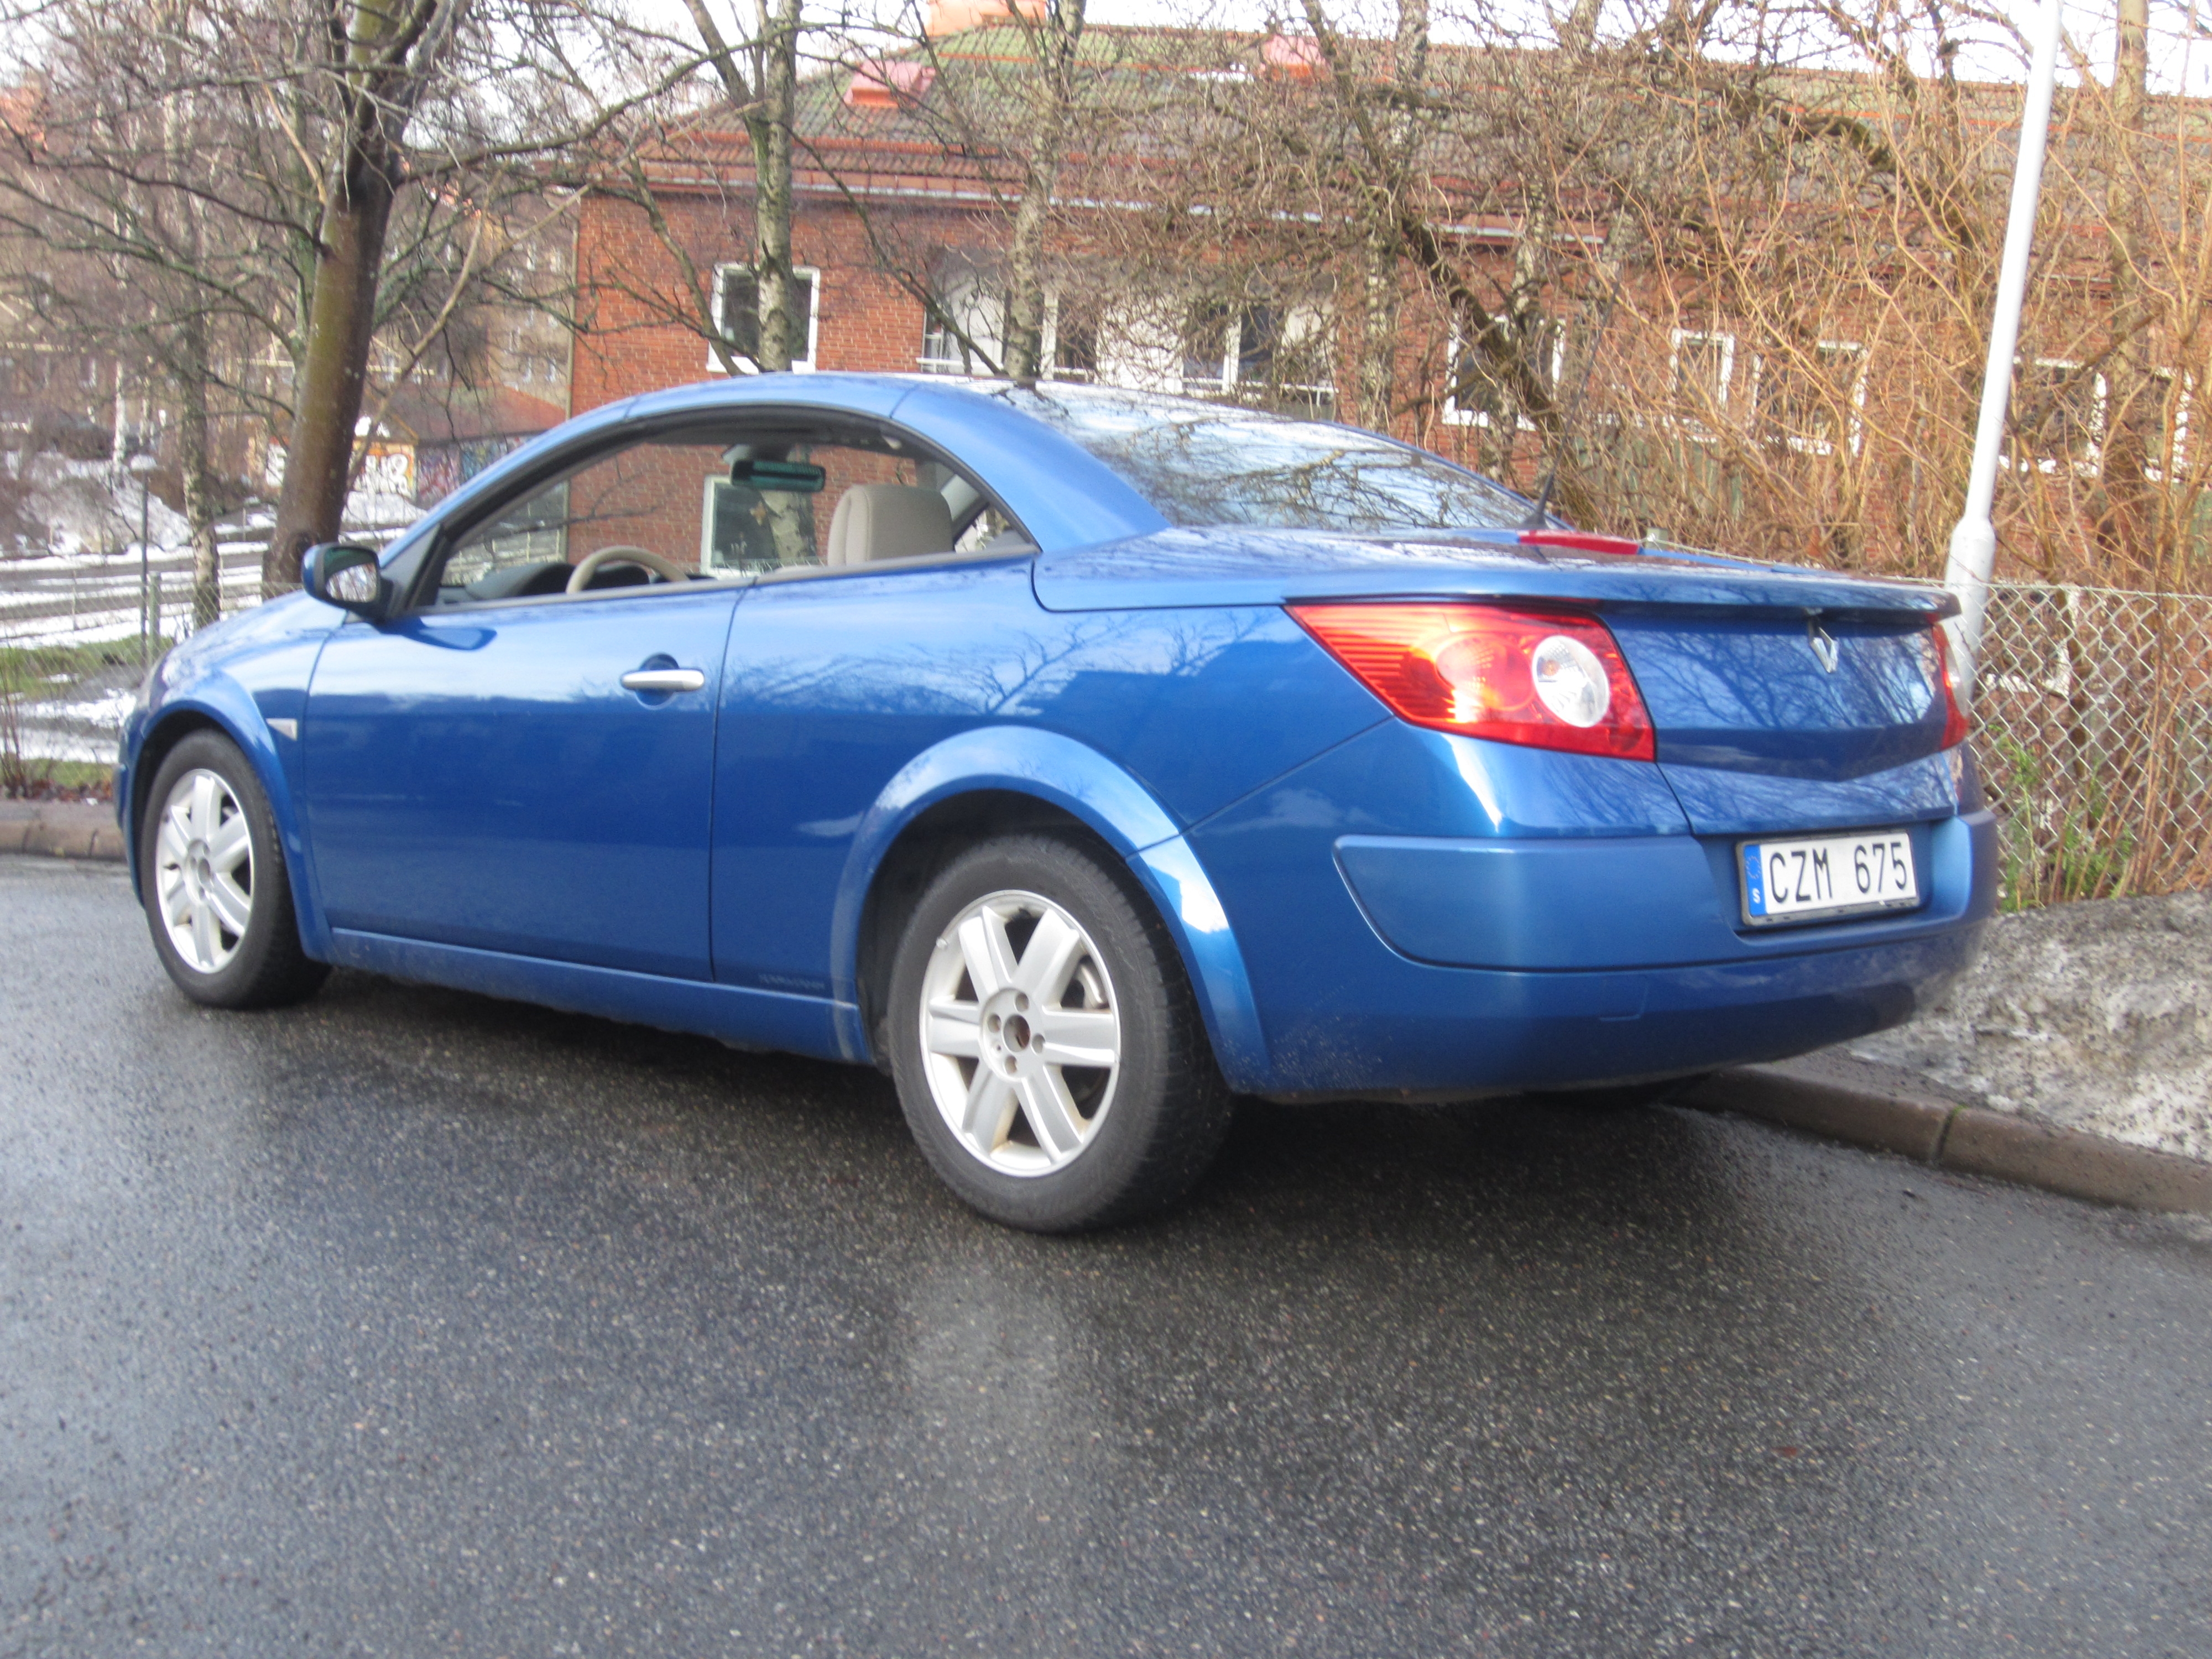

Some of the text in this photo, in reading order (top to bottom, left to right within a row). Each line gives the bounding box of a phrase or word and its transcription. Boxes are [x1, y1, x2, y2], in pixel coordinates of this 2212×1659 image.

[1770, 841, 1907, 904] CZM 675
[1752, 887, 1761, 904] S
